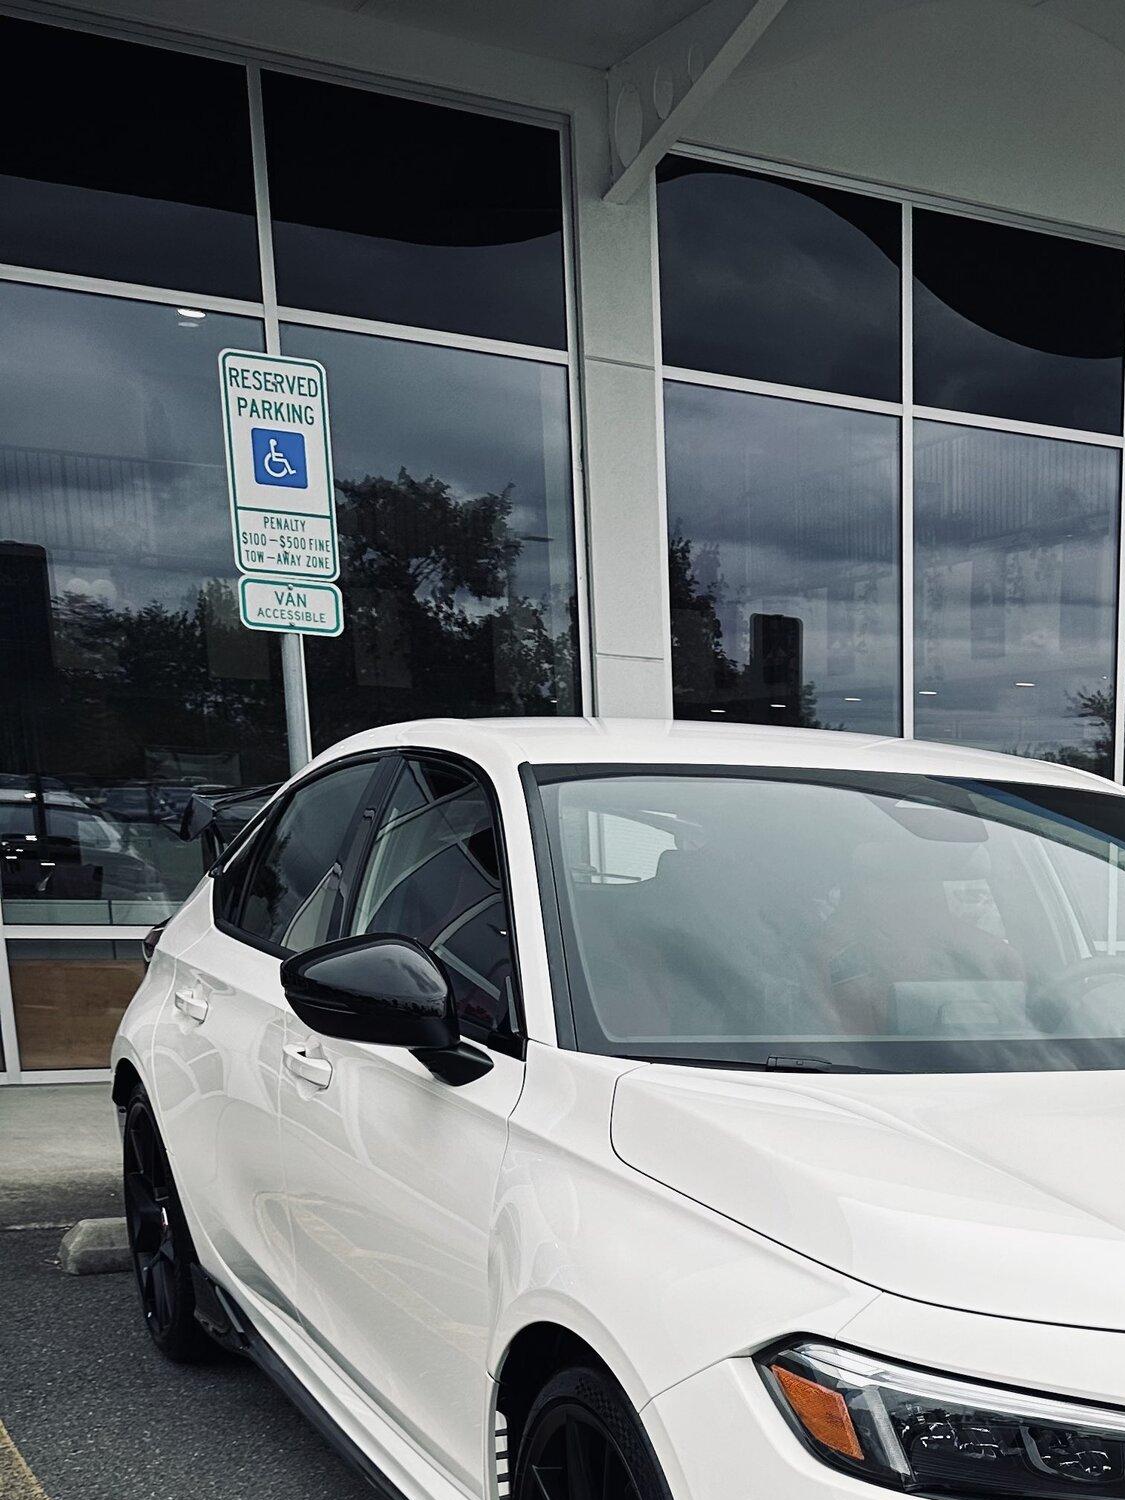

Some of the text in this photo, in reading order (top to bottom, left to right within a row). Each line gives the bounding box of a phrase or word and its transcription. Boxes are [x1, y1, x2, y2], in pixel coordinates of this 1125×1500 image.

[229, 367, 318, 398] RESERVED
[237, 397, 315, 426] PARKING
[263, 516, 306, 532] PENALTY
[309, 538, 331, 552] FINE
[306, 555, 331, 570] ZONE
[274, 591, 307, 608] VAN
[257, 608, 327, 623] ACCESSIBLE
